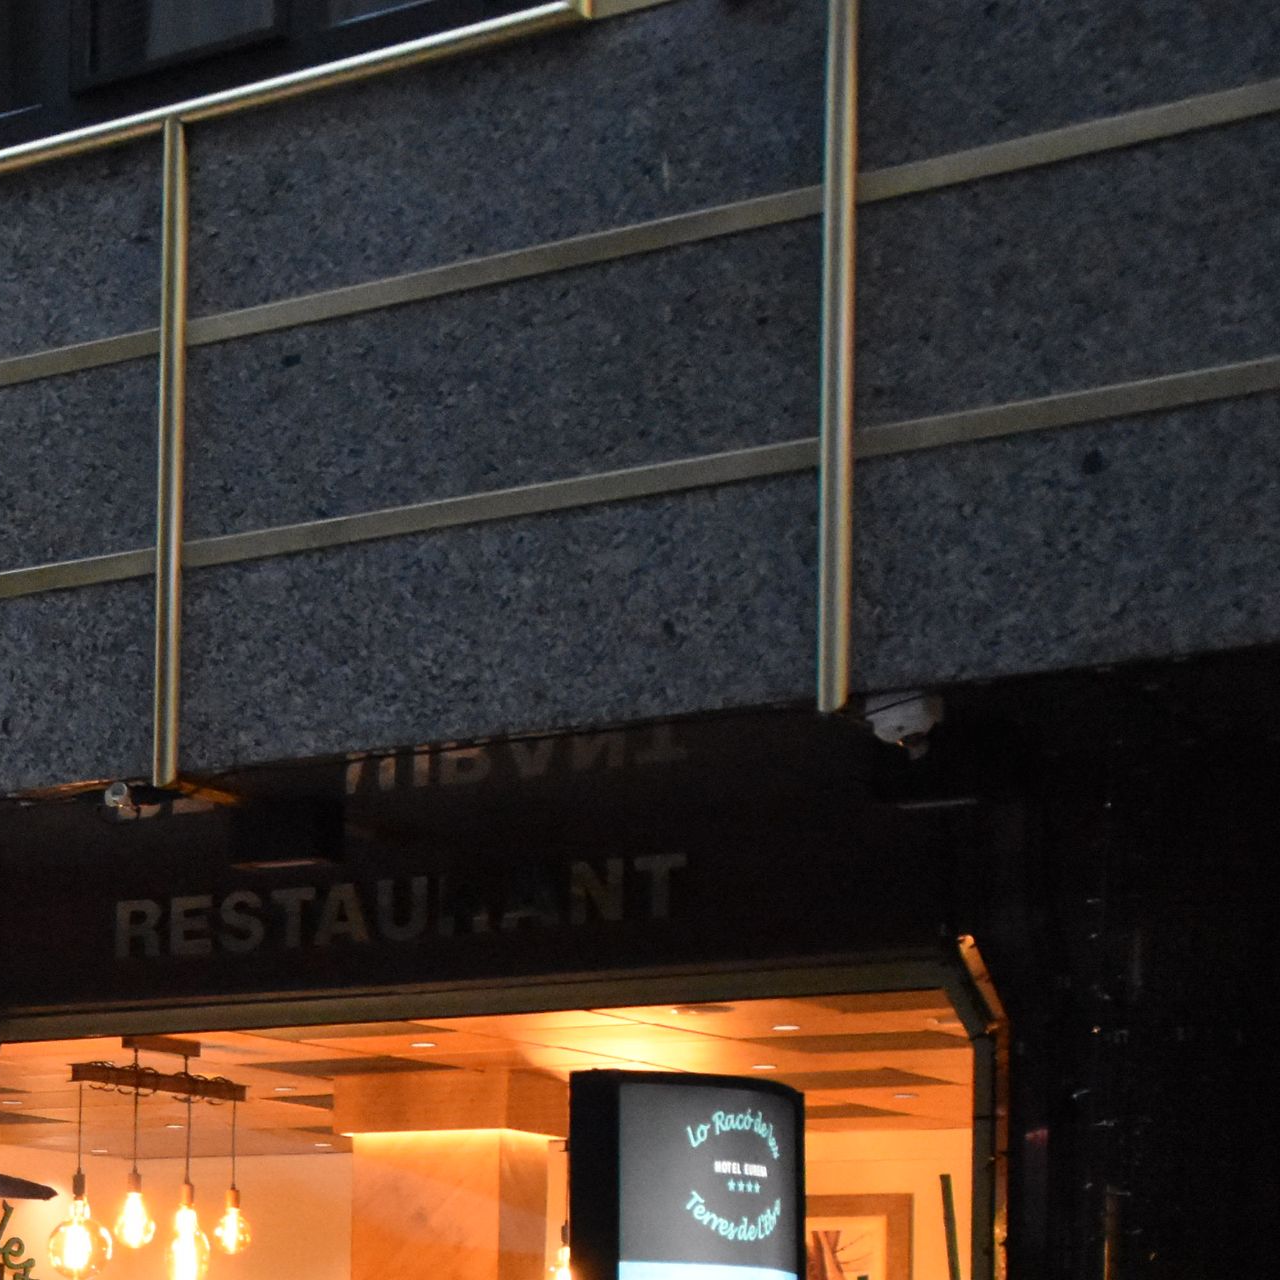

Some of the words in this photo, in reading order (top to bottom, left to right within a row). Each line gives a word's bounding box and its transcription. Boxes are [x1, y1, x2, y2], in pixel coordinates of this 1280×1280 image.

[686, 1123, 711, 1148] Lo
[713, 1160, 742, 1175] HOTEL
[686, 1190, 737, 1240] Terres
[737, 1216, 757, 1241] de
